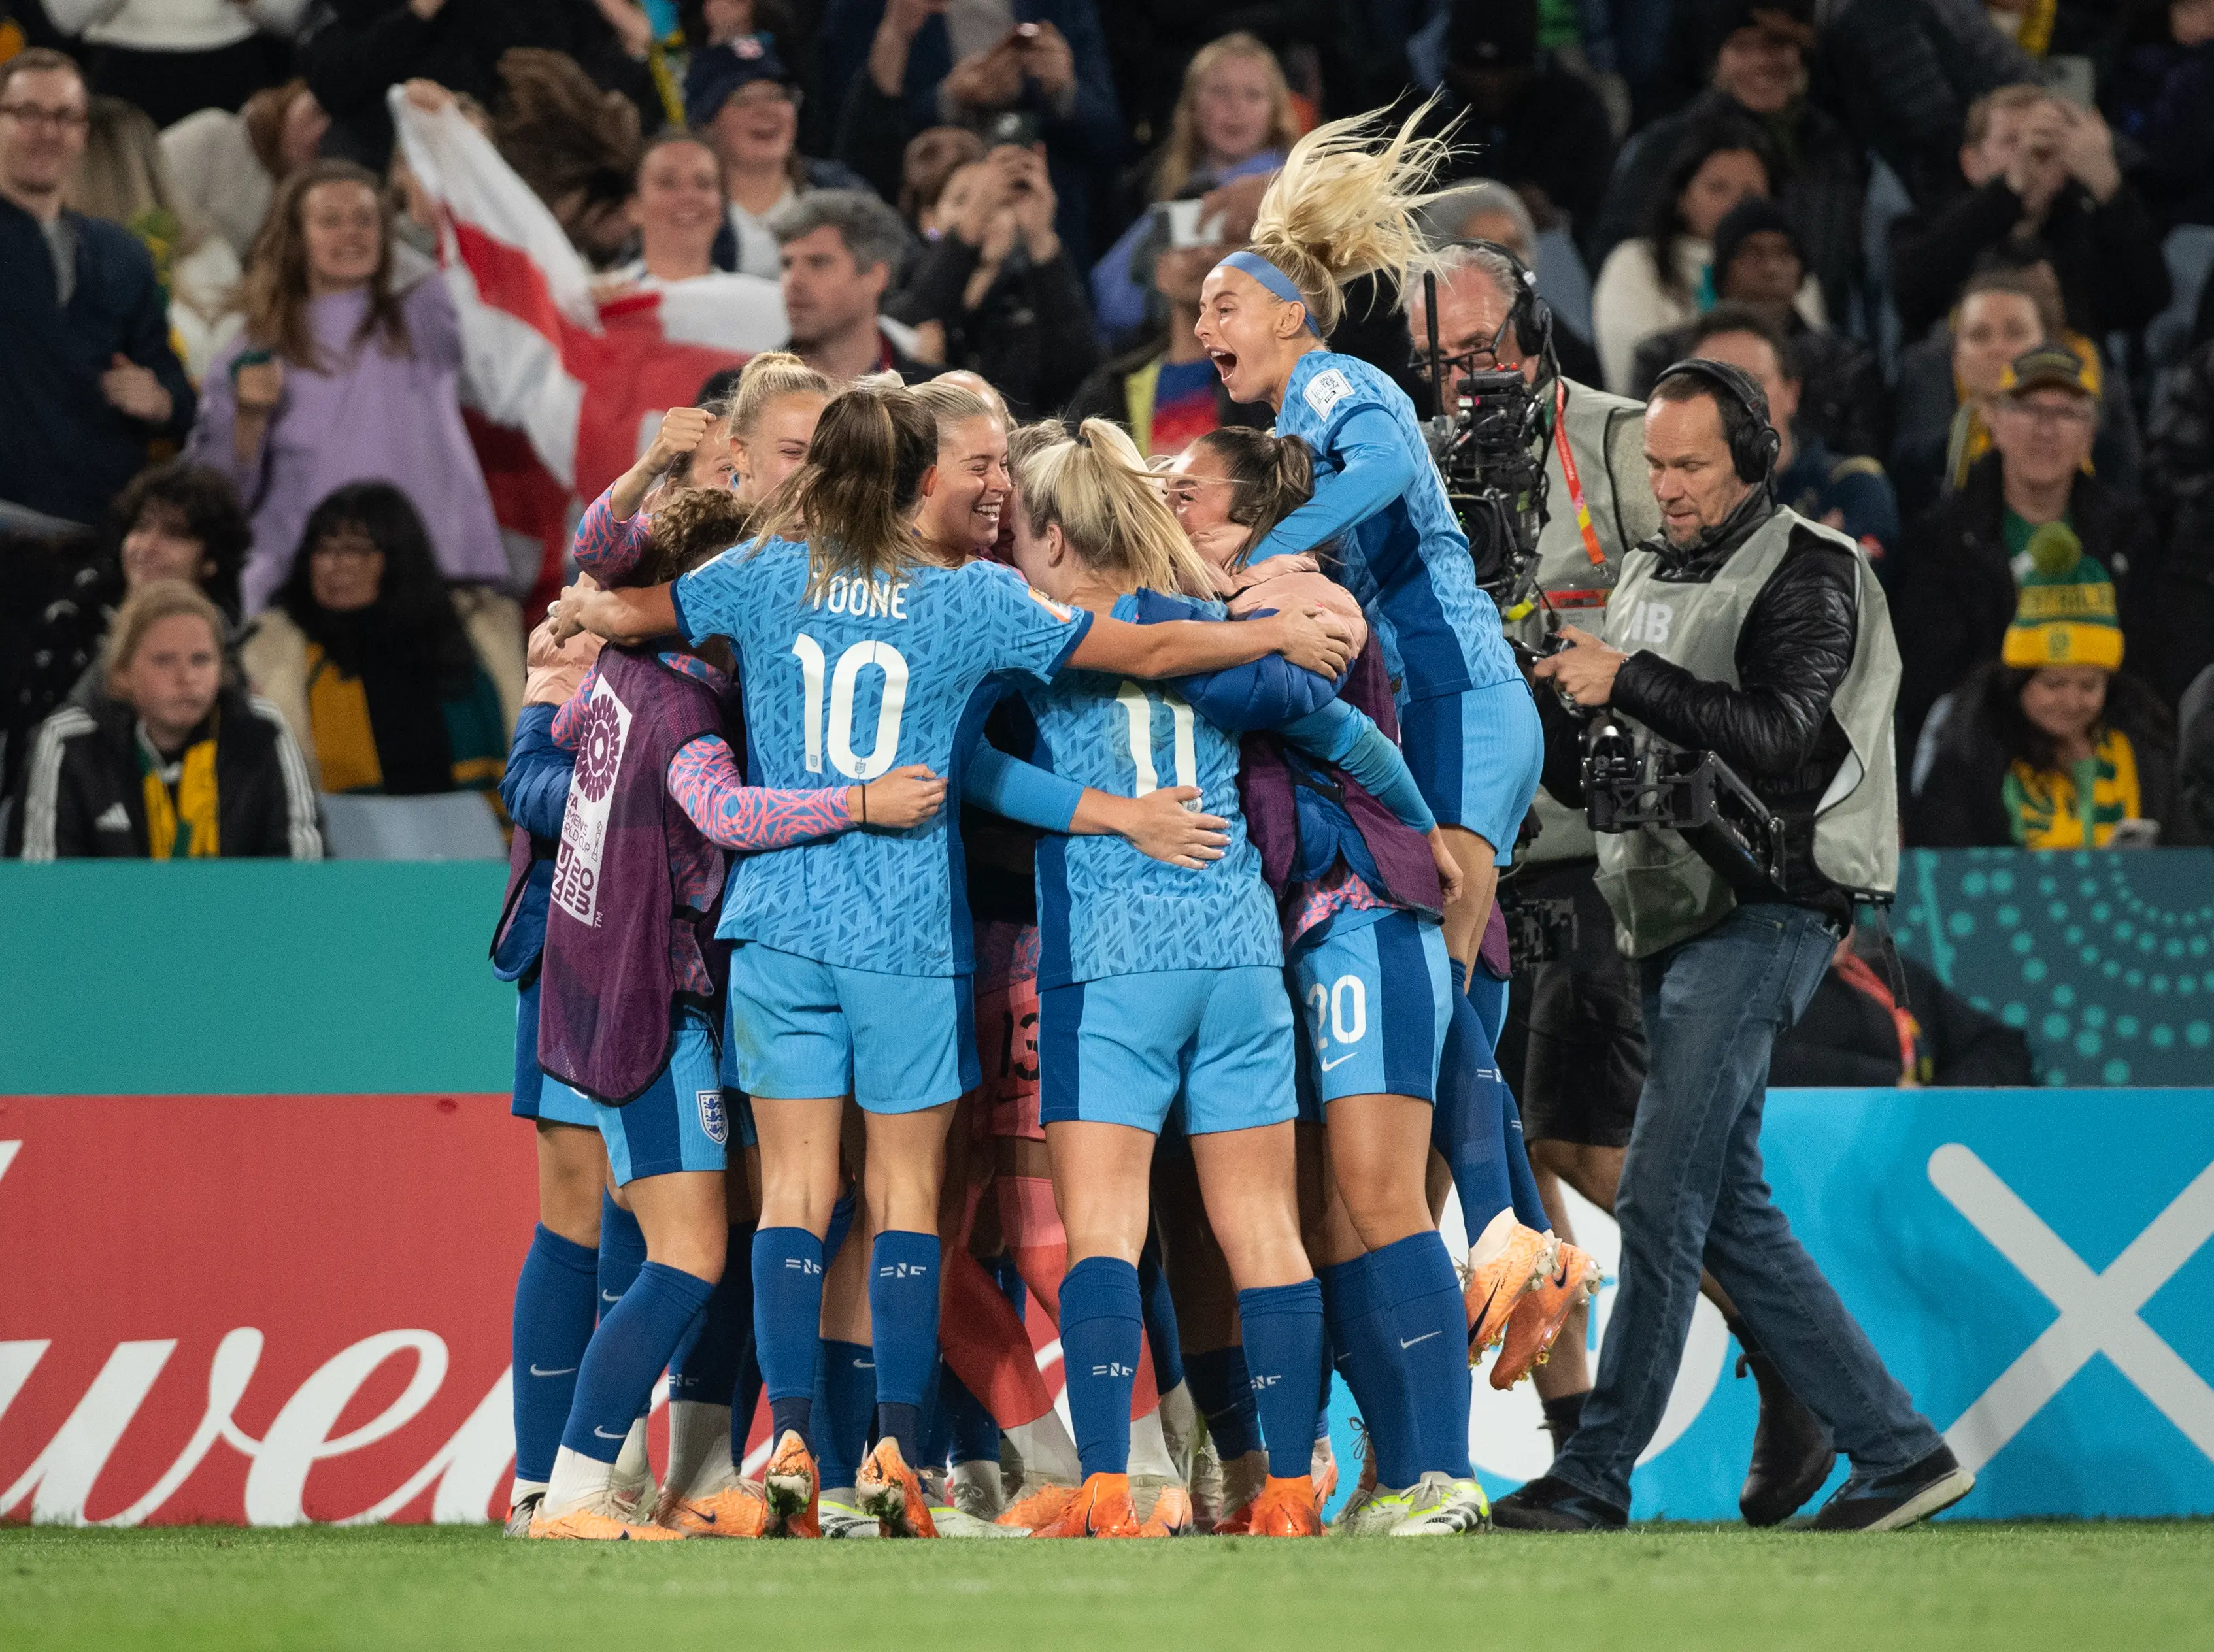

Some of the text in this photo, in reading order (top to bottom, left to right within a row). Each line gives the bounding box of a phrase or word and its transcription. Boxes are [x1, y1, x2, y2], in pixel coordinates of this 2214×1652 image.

[792, 633, 909, 780] 10
[1115, 679, 1203, 814] 11
[1307, 974, 1367, 1051] 20
